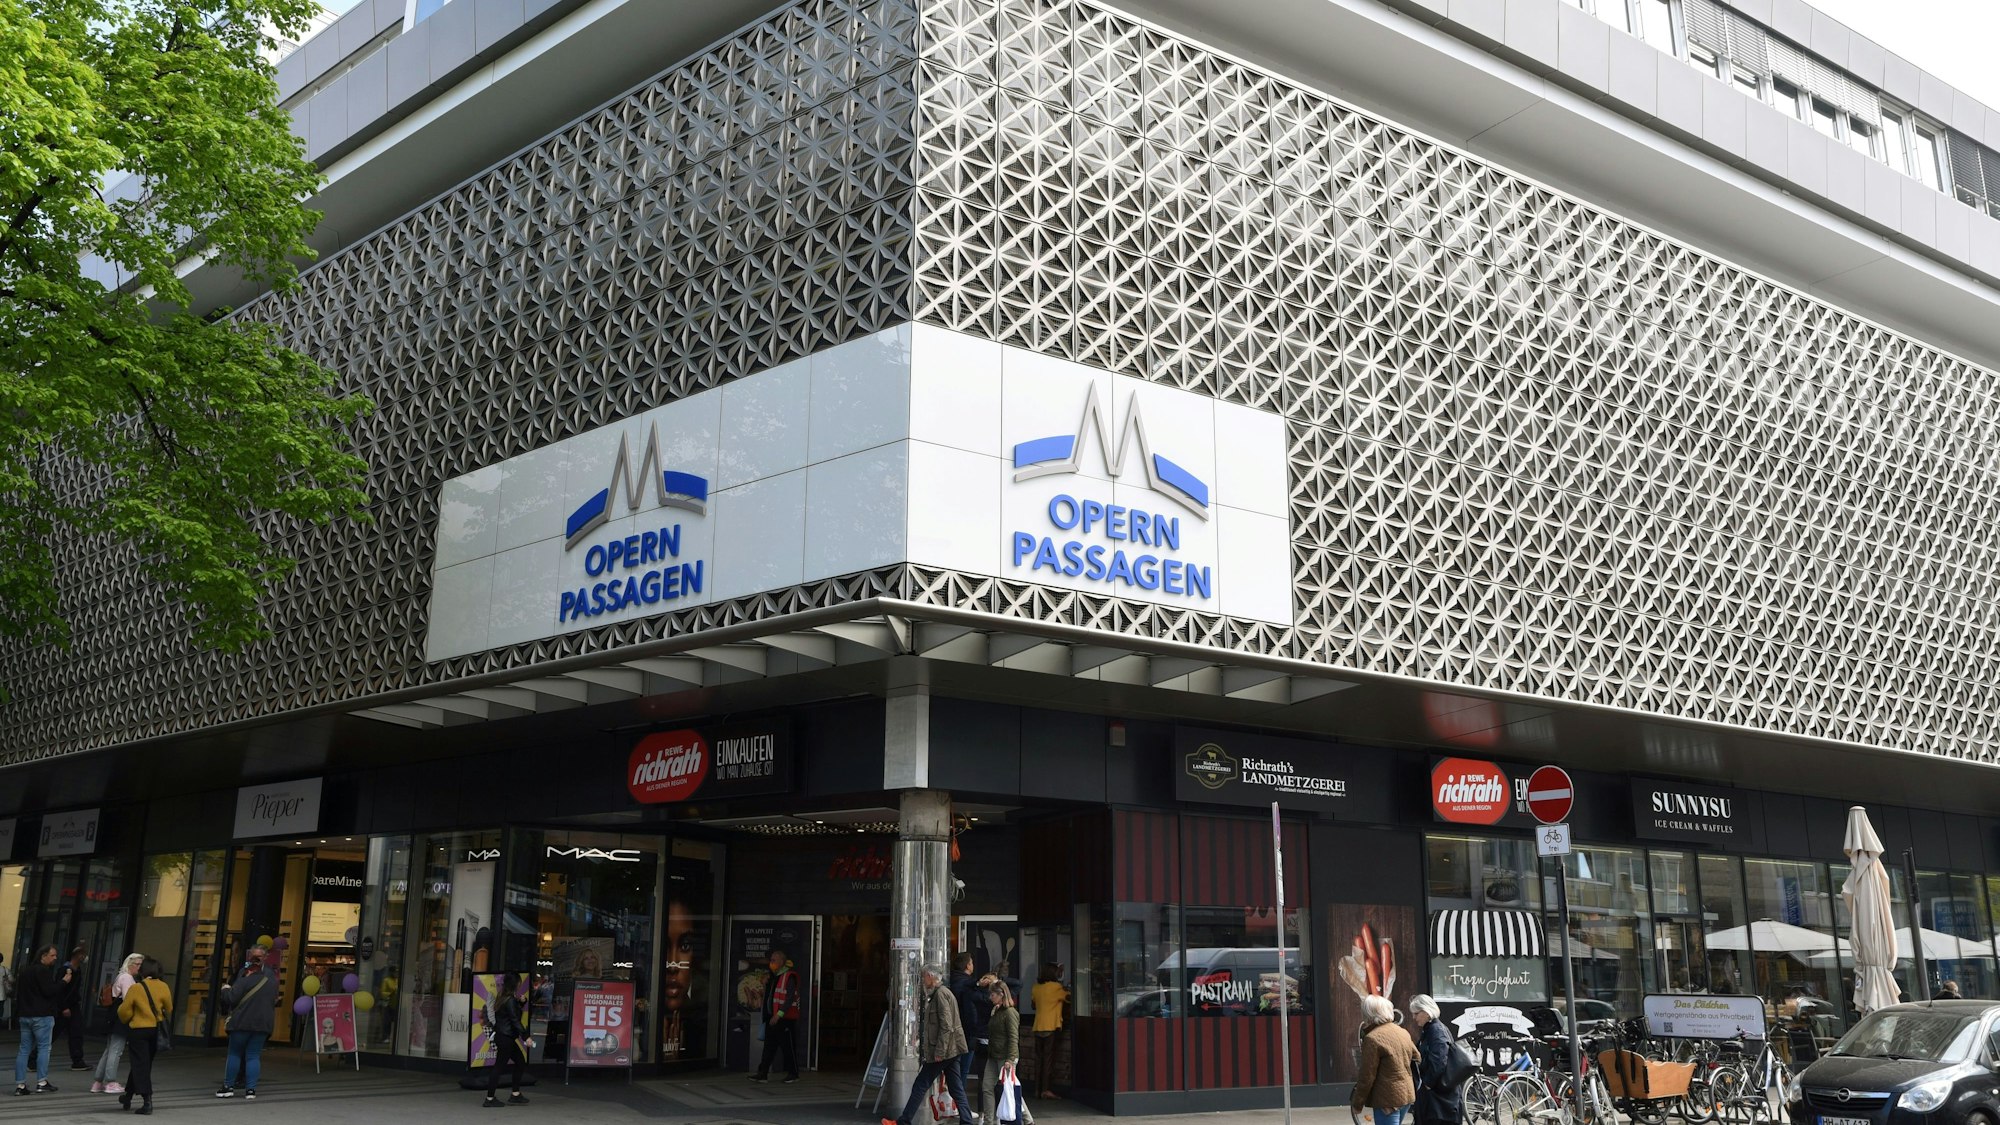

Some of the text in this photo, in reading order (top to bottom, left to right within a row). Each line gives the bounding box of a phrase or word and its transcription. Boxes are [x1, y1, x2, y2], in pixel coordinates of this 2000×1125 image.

[1050, 493, 1179, 550] OPERN
[585, 524, 681, 577] OPERN
[1013, 531, 1212, 599] PASSAGEN
[559, 559, 704, 623] PASSAGEN
[664, 745, 684, 757] REWE
[716, 734, 774, 766] EINKAUFEN
[632, 742, 702, 786] richrath
[716, 767, 726, 780] WO
[1242, 757, 1294, 774] Richrath's
[646, 783, 655, 792] AUS
[671, 777, 688, 788] REGION
[1242, 771, 1346, 792] LANDMETZGEREI
[1438, 774, 1503, 803] richrath
[1467, 774, 1486, 782] REWE
[252, 793, 304, 826] Pieper
[1652, 791, 1731, 819] SUNNYSU
[1654, 819, 1733, 833] ICE CREAM & WAFFLES
[1549, 844, 1560, 852] frei
[851, 882, 865, 891] Wir
[1191, 979, 1253, 1006] PASTRAMI
[1448, 964, 1531, 999] Frozn Joghurt
[1674, 999, 1691, 1010] Das
[583, 1005, 622, 1027] EIS
[1653, 1011, 1707, 1020] Wertgegenstände
[1720, 1013, 1755, 1021] Privatbesitz
